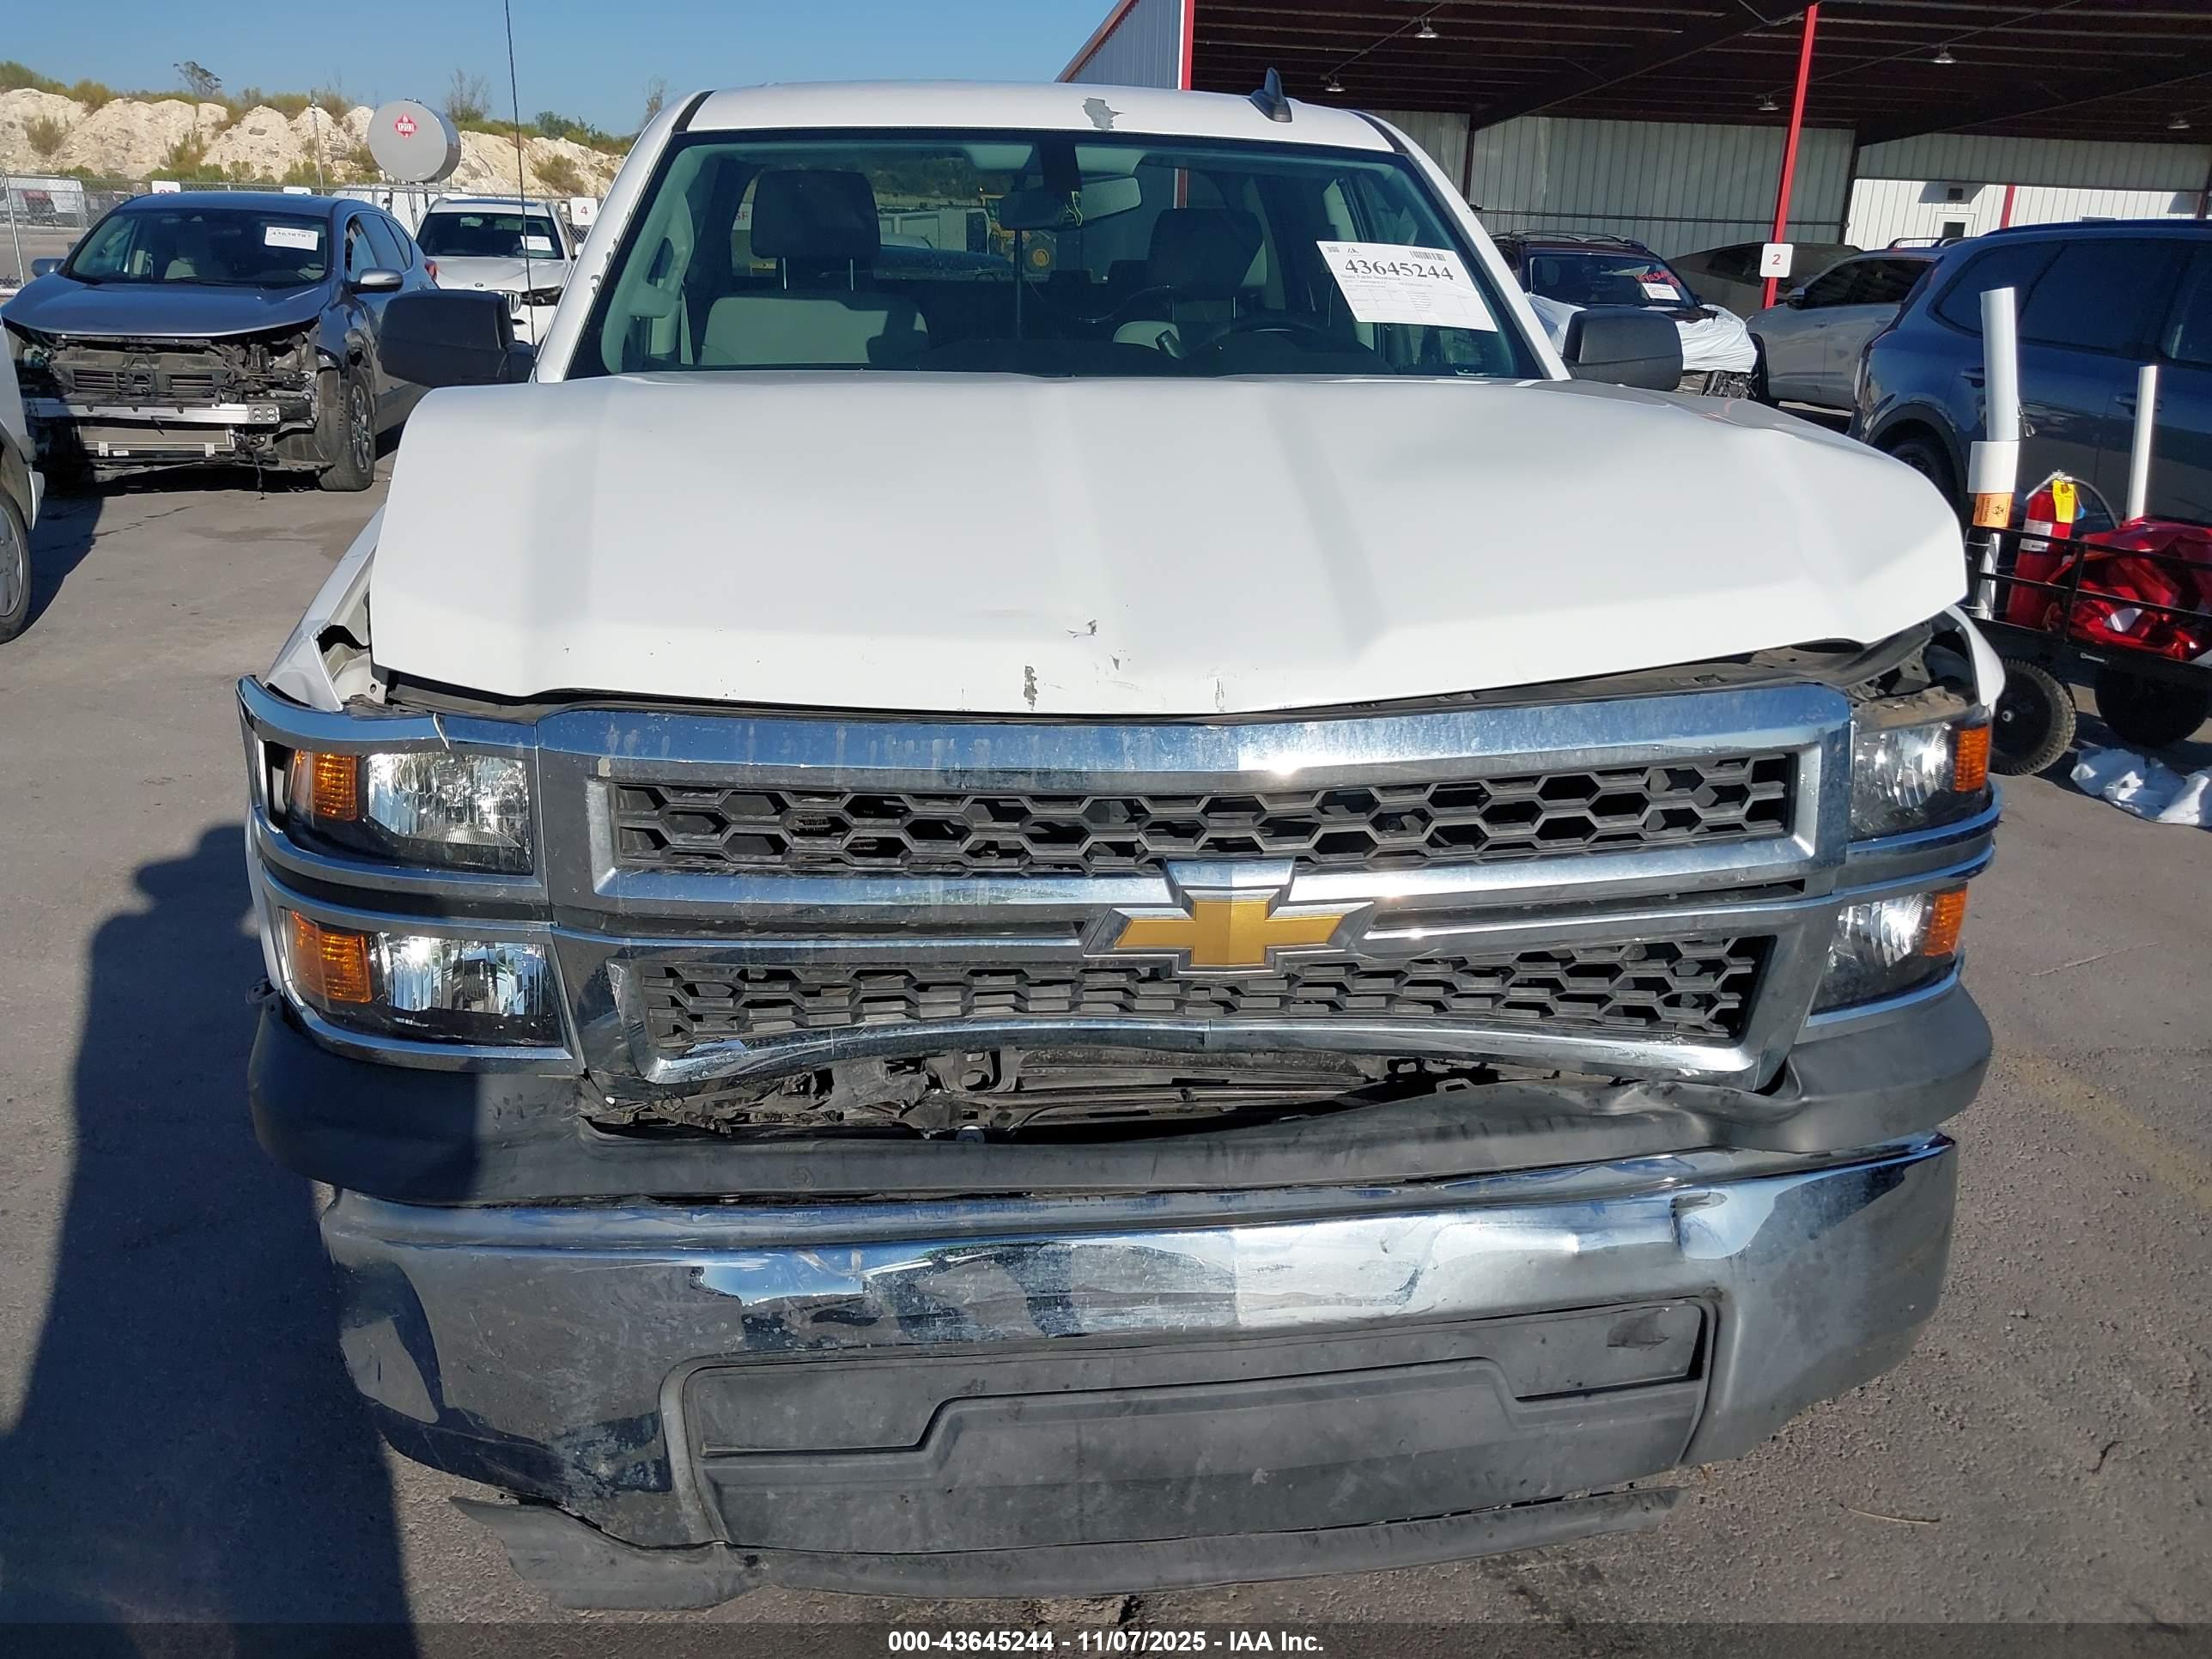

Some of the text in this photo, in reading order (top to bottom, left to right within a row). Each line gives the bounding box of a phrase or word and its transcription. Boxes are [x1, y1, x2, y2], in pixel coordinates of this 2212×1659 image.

[580, 205, 589, 216] 4
[1771, 253, 1782, 265] 2
[1345, 259, 1454, 280] 43645244
